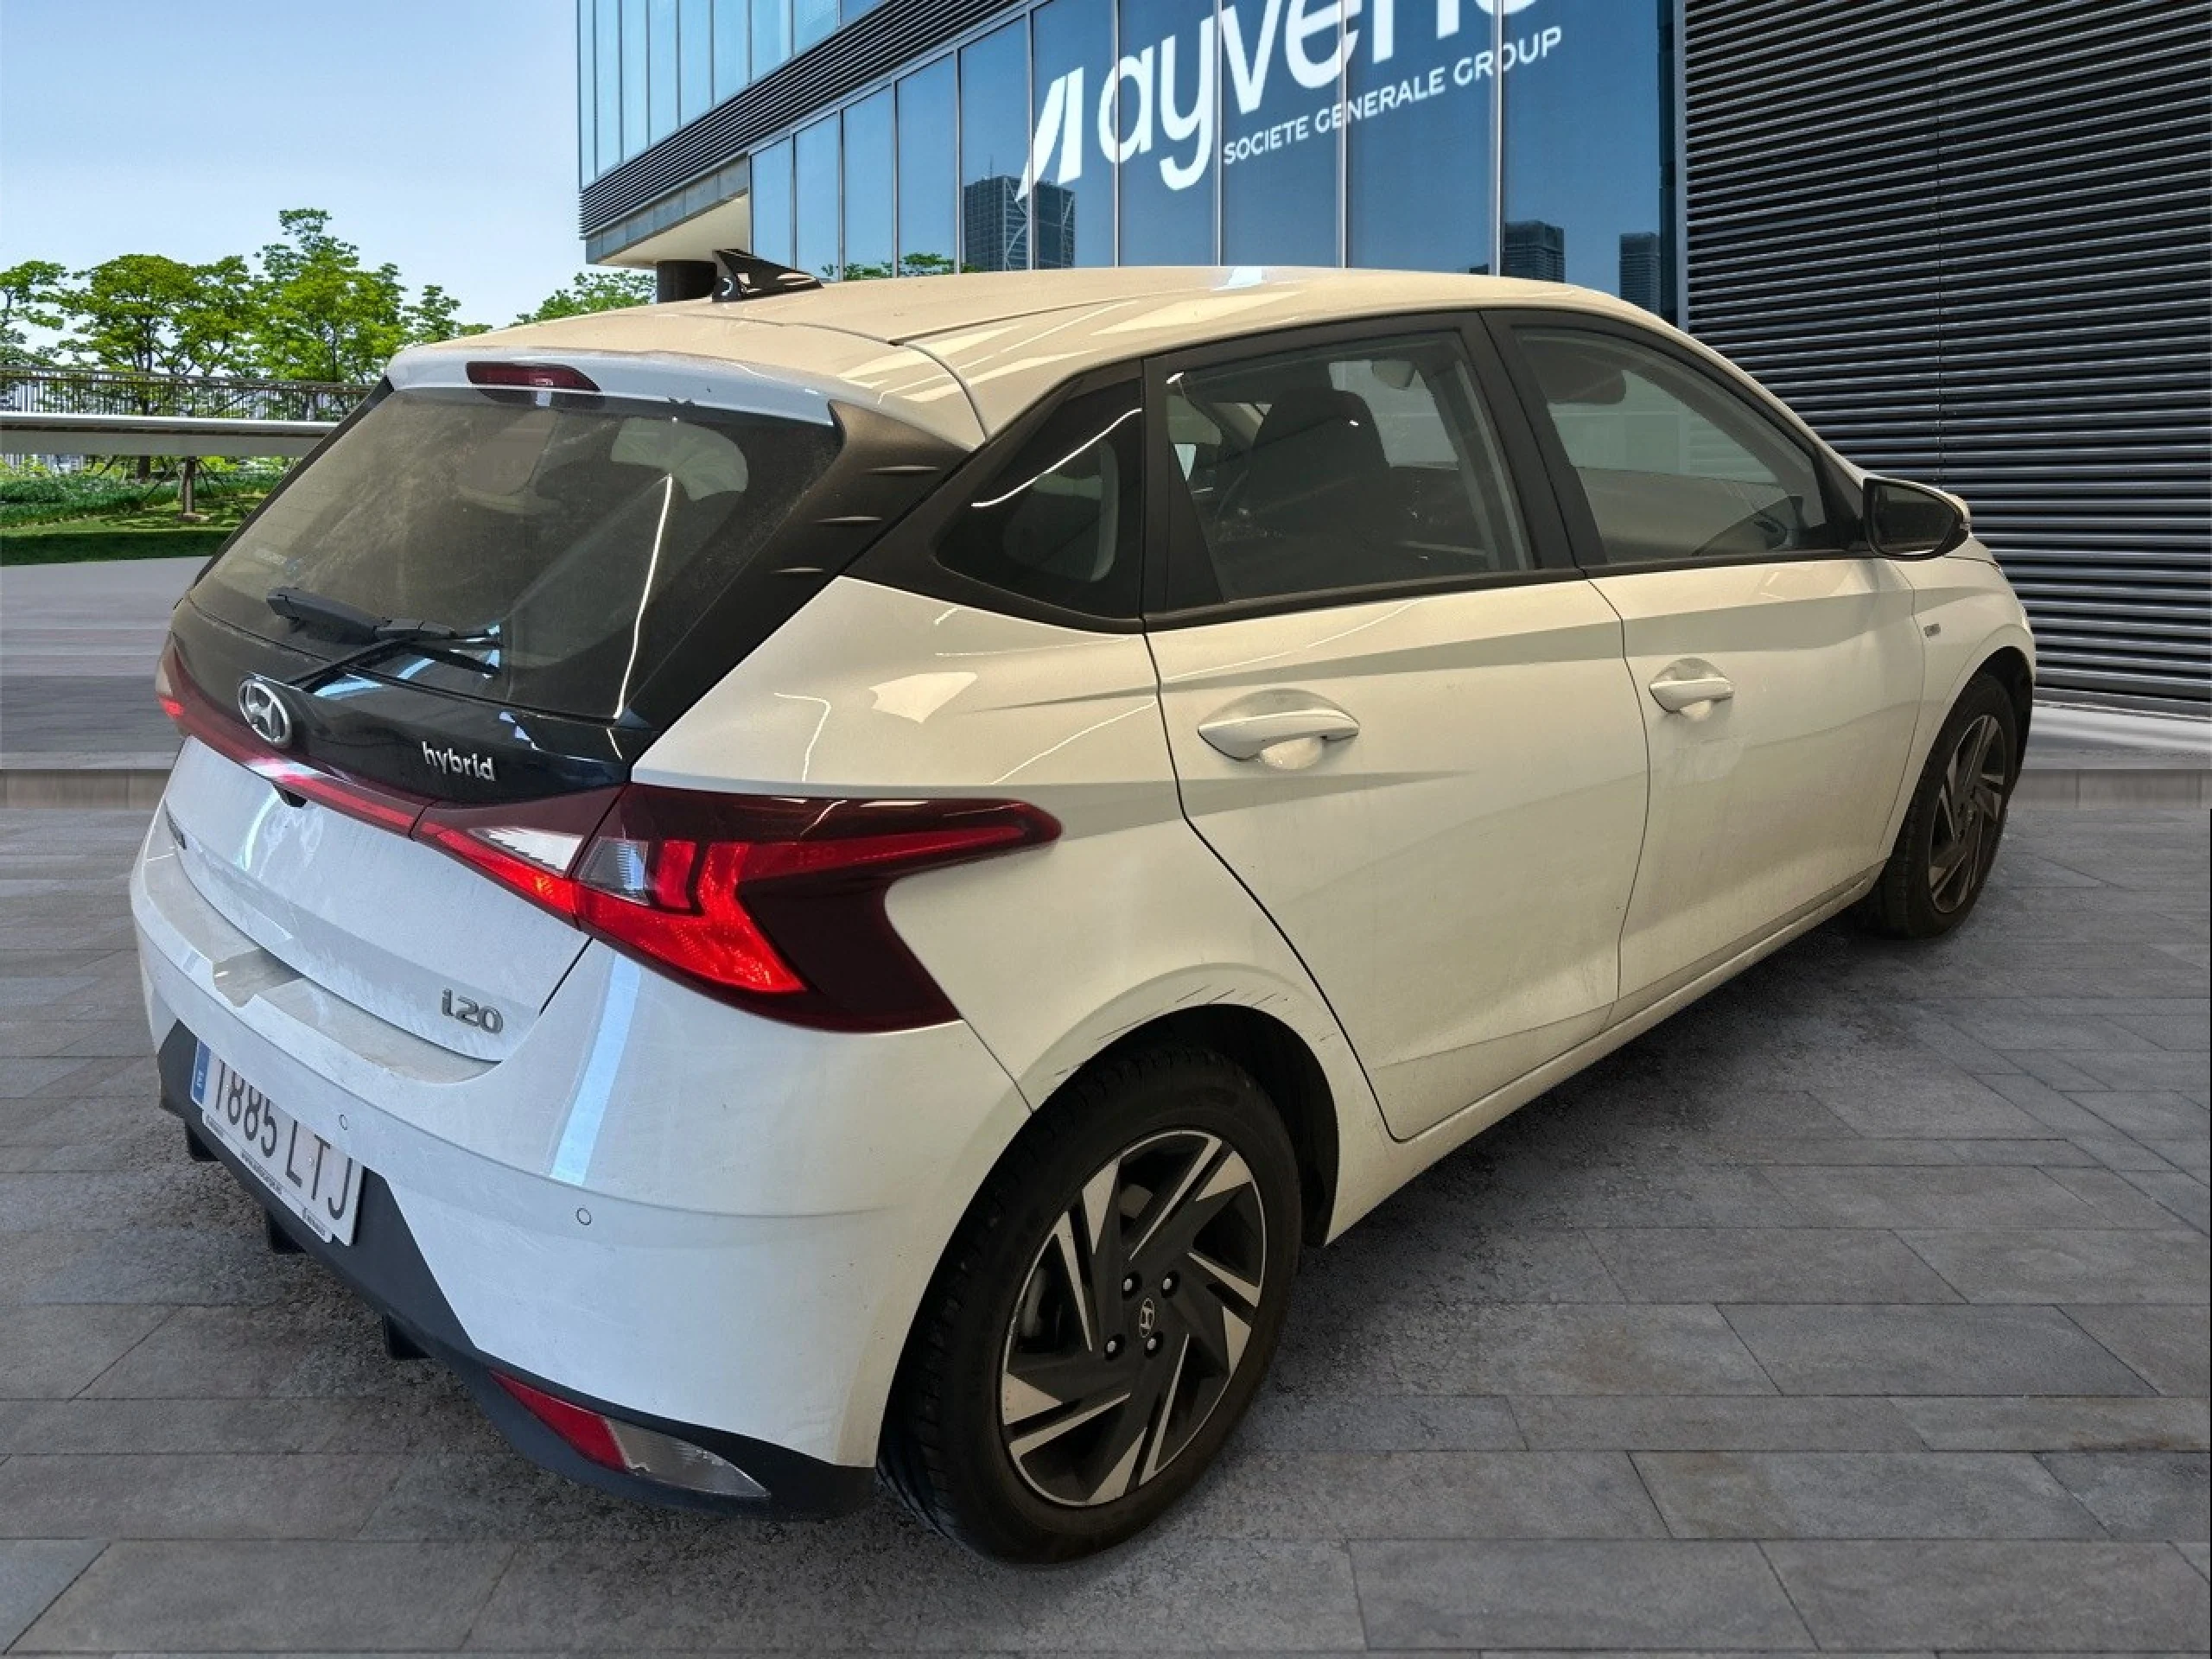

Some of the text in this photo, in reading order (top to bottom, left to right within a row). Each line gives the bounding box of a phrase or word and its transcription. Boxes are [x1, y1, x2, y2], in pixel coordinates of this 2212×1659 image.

[1097, 0, 1538, 190] ayve
[1224, 25, 1562, 165] SOCIETE GENERALE GROUP
[421, 741, 497, 782] hybrid
[216, 1059, 278, 1159] 1885
[285, 1119, 353, 1221] LTJ
